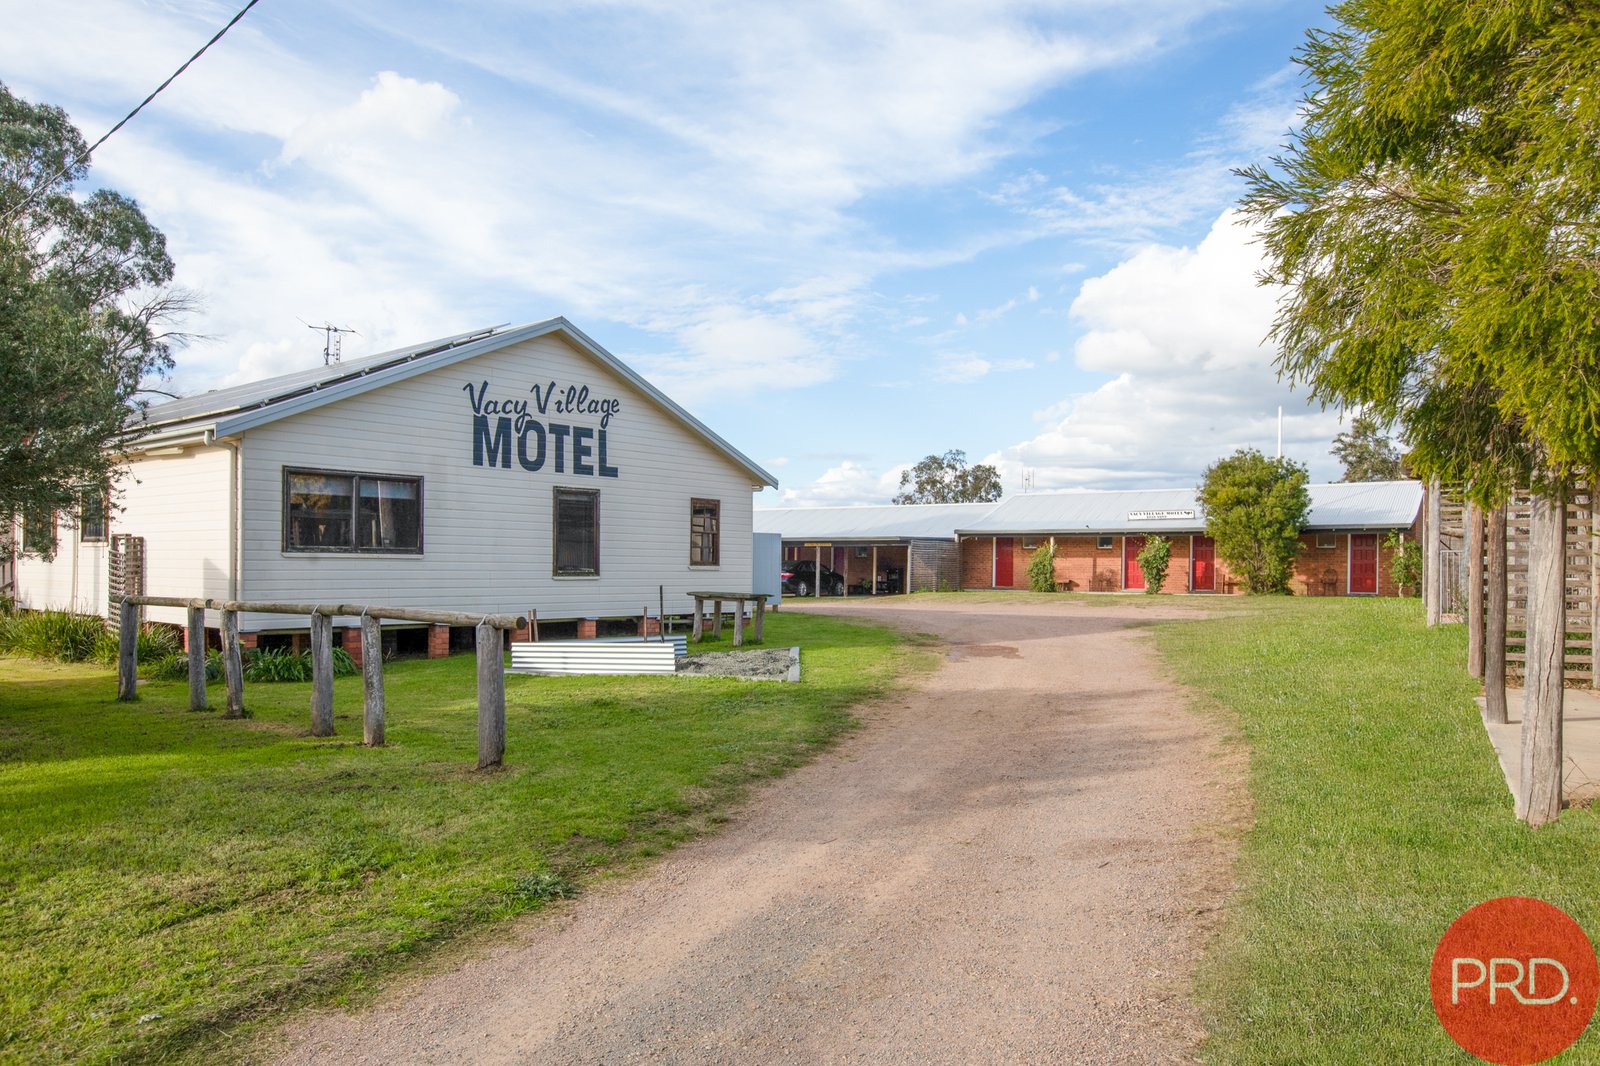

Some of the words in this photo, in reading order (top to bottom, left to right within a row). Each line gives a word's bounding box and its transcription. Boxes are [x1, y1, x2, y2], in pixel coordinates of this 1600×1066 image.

[462, 380, 532, 435] Vacy
[530, 381, 620, 430] Village
[473, 414, 619, 478] MOTEL
